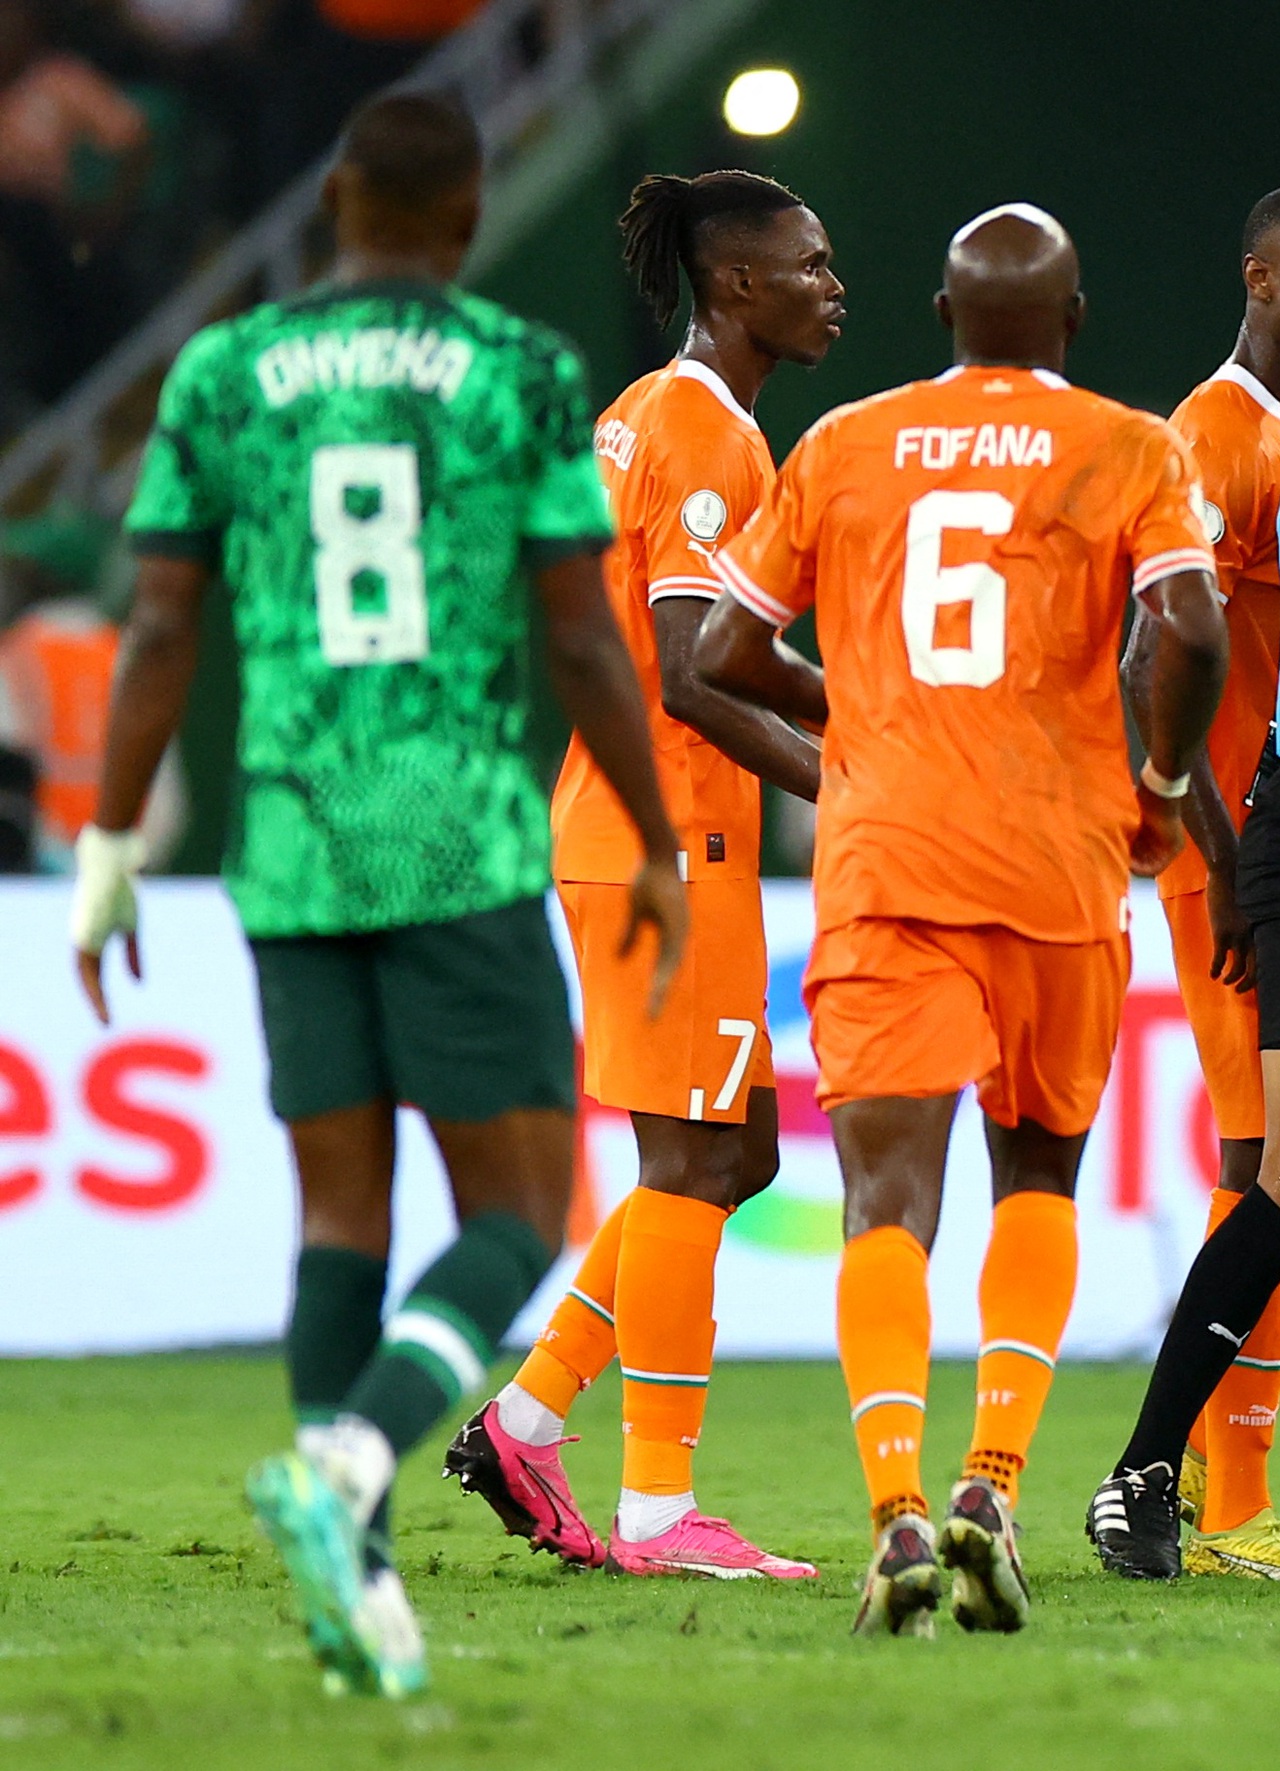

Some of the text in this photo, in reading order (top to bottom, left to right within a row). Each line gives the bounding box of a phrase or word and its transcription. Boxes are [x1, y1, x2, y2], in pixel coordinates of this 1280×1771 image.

[894, 423, 1052, 470] FOFANA
[309, 443, 430, 668] 8
[901, 489, 1015, 690] 6
[712, 1018, 757, 1111] 7
